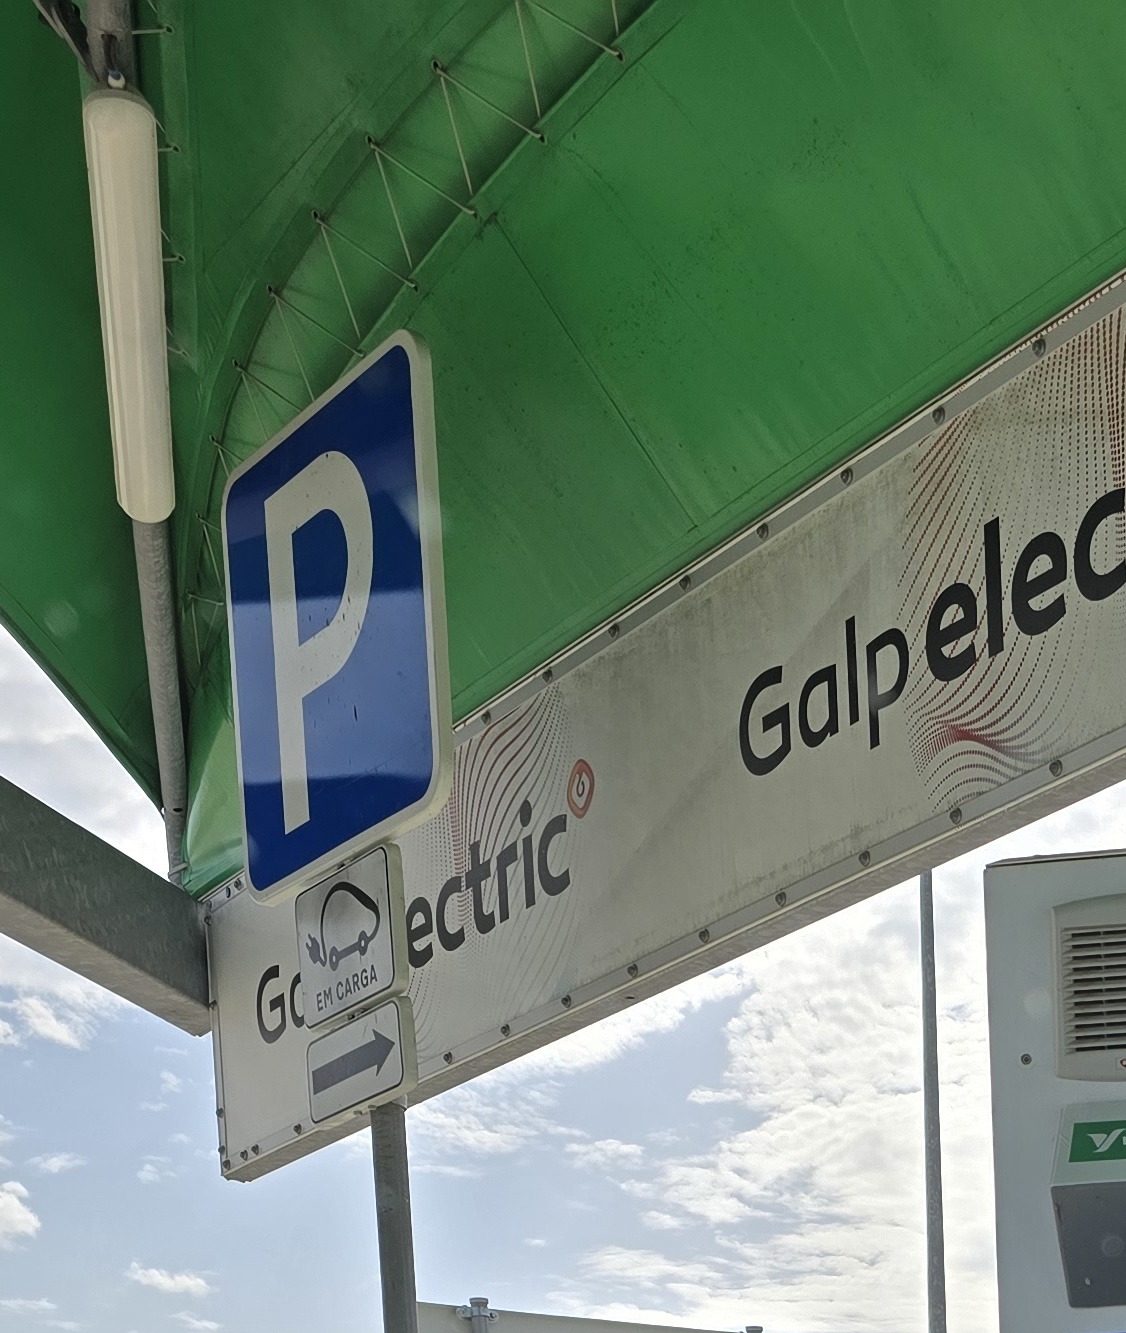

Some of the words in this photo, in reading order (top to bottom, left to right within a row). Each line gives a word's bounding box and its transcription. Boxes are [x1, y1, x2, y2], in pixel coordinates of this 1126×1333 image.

[265, 450, 374, 835] P
[316, 989, 334, 1012] EM
[336, 964, 378, 1000] CARGA
